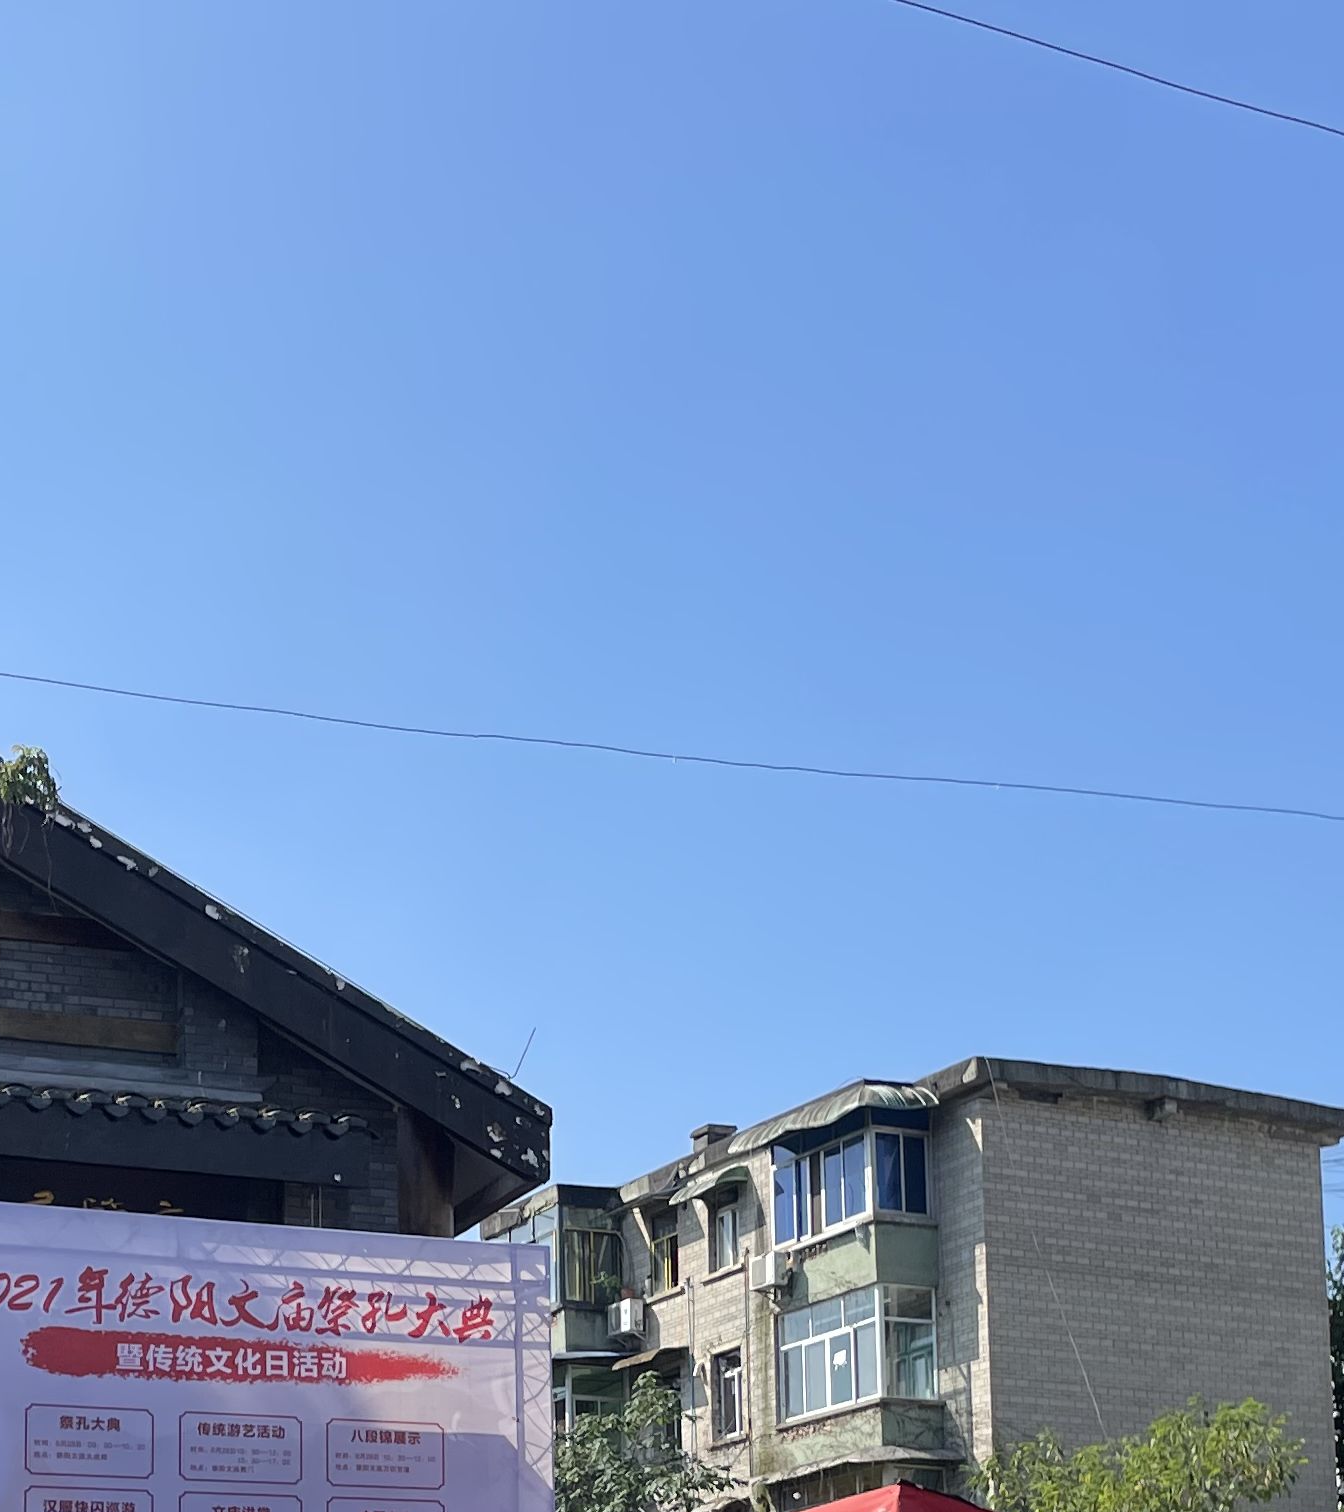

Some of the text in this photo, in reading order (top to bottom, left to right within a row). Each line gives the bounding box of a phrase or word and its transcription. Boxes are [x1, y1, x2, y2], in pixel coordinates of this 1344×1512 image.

[115, 1341, 348, 1378] 暨传统文化日活动
[59, 1414, 121, 1432] 祭孔大典
[197, 1421, 286, 1439] 传统游艺活动
[350, 1428, 421, 1445] 八段锦展示
